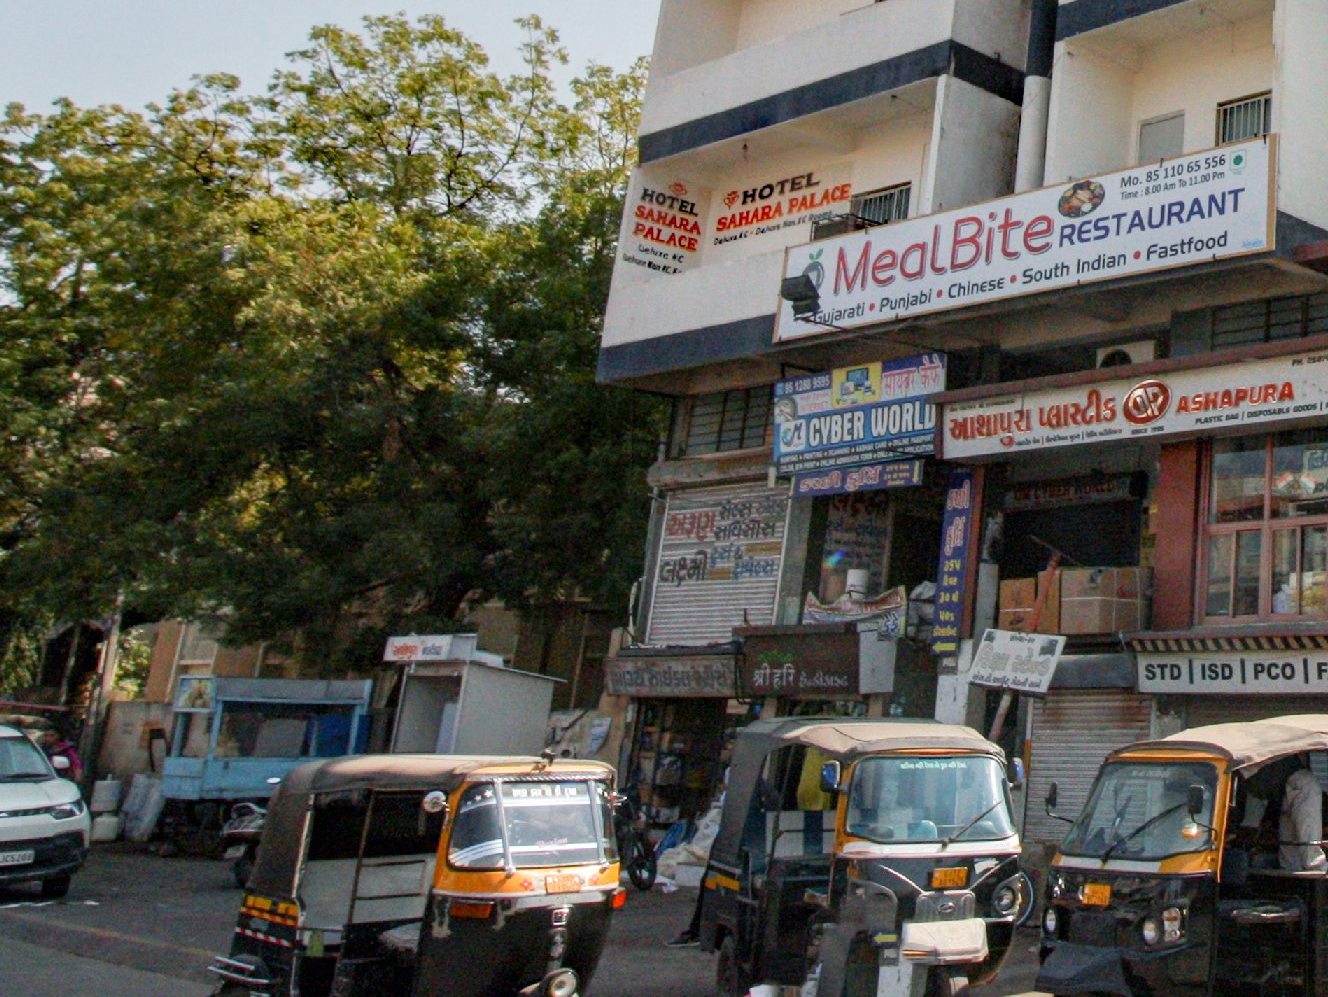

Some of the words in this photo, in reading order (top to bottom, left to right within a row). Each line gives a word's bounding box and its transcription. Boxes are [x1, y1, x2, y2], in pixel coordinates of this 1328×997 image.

[1120, 175, 1142, 189] Mo.
[1145, 170, 1159, 183] 85
[1163, 165, 1183, 179] 110
[1187, 161, 1201, 175] 65
[1204, 154, 1226, 171] 556
[1120, 190, 1139, 201] Time
[1144, 184, 1162, 196] 8.00
[1163, 181, 1176, 192] Am
[1178, 178, 1187, 189] To
[1189, 174, 1210, 187] 11.00
[1212, 170, 1225, 181] Pm
[641, 188, 698, 217] HOTEL
[742, 172, 820, 205] HOTEL
[635, 205, 701, 236] SAHARA
[715, 199, 784, 232] SAHARA
[788, 183, 852, 214] PALACE
[1059, 188, 1245, 248] RESTAURANT
[633, 223, 697, 251] PALACE
[833, 207, 1054, 296] MealBite
[813, 302, 865, 325] Gujarati
[879, 288, 932, 316] Punjabi
[948, 277, 1005, 299] Chinese
[1022, 261, 1069, 284] South
[1077, 252, 1126, 274] Indian
[1147, 230, 1228, 261] Fastfood
[1175, 381, 1295, 413] ASHAPURA
[1195, 413, 1223, 425] PLASTIC
[1225, 411, 1239, 421] BAG
[1246, 406, 1290, 419] DISPOSABLE
[1293, 402, 1317, 413] GOODS
[809, 411, 864, 447] CYBER
[871, 401, 936, 437] WORLD
[949, 407, 1033, 449] આશાપુરા
[1145, 663, 1182, 681] STD
[1201, 663, 1234, 681] ISD
[1253, 662, 1296, 681] PCO
